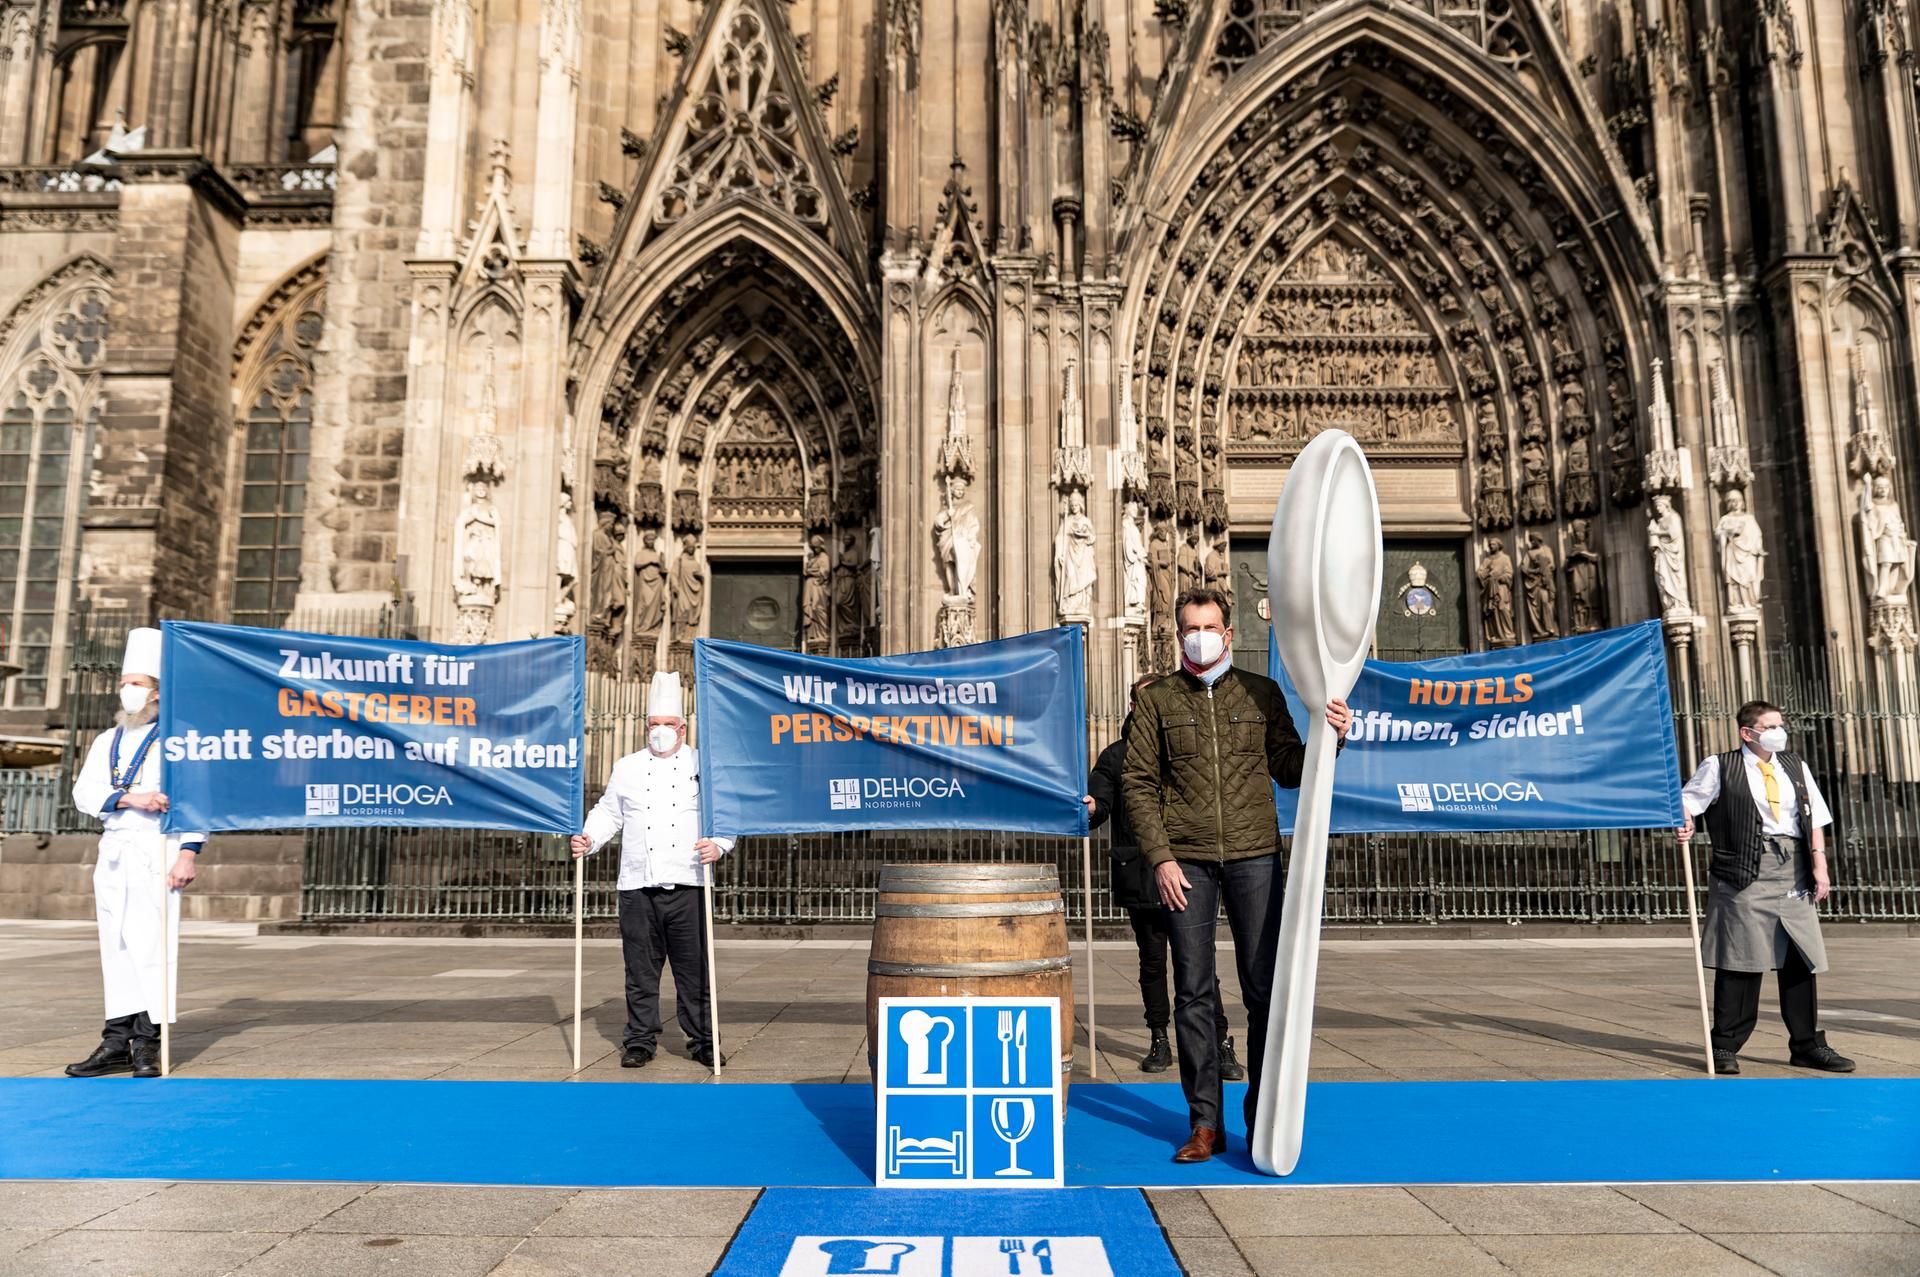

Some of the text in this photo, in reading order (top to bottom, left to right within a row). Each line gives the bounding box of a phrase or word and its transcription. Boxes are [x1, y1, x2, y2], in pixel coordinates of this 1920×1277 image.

[278, 649, 475, 686] Zukunft für
[783, 675, 998, 705] Wir brauchen
[1409, 673, 1534, 705] HOTELS
[278, 688, 476, 726] GASTGEBER
[770, 714, 1015, 746] PERSPEKTIVEN!
[1345, 704, 1585, 747] öffnen, sicher!
[164, 728, 252, 761] statt
[262, 729, 395, 760] sterben
[404, 737, 460, 767] auf
[468, 738, 578, 768] Raten!
[343, 784, 453, 806] DEHOGA
[864, 777, 966, 799] DEHOGA
[1435, 781, 1542, 801] DEHOGA
[343, 808, 405, 816] NORDRHEIN
[864, 801, 922, 809] NORDRHEIN
[1437, 804, 1499, 812] NORDRHEIN
